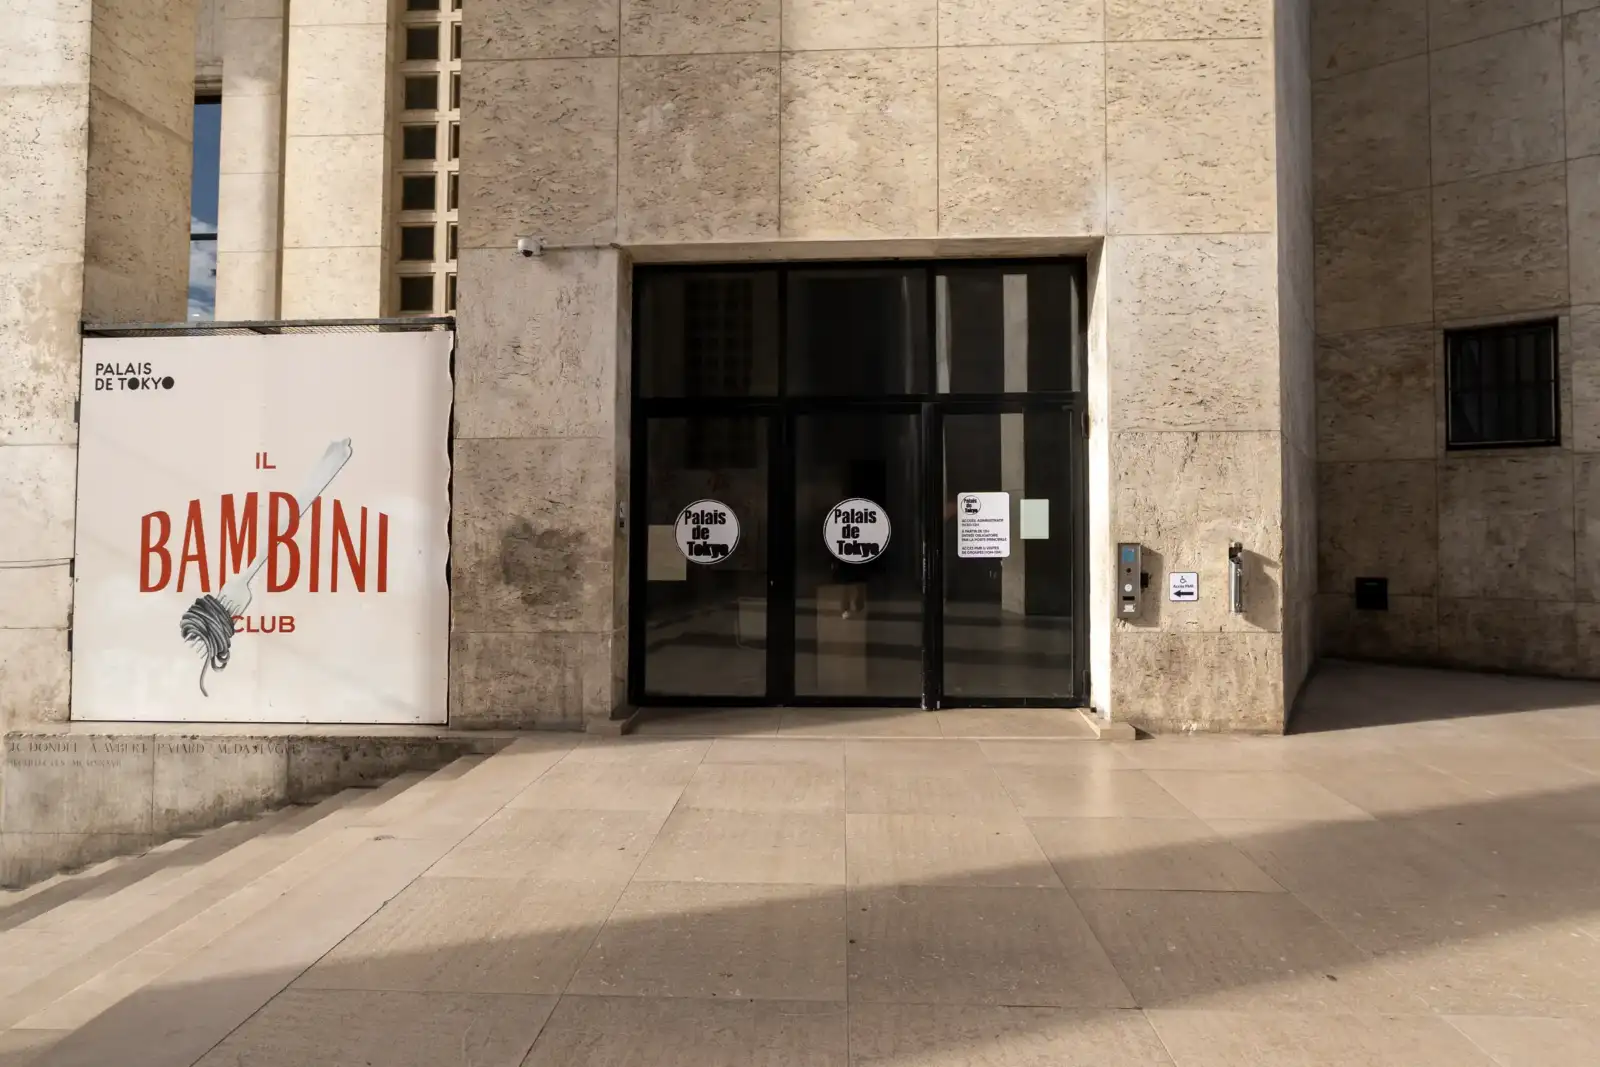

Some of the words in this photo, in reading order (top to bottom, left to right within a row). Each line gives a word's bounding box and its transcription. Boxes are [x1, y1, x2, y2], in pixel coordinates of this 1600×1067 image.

[96, 362, 152, 376] PALAIS
[95, 377, 114, 390] DE
[117, 376, 175, 390] TOKYO
[255, 452, 277, 470] IL
[684, 510, 726, 525] Palais
[834, 508, 877, 524] Palais
[692, 525, 710, 540] de
[842, 524, 860, 539] de
[139, 491, 389, 593] BAMBINI
[687, 541, 729, 558] Tokyo
[837, 540, 880, 557] Tokyo
[231, 615, 296, 633] CLUB
